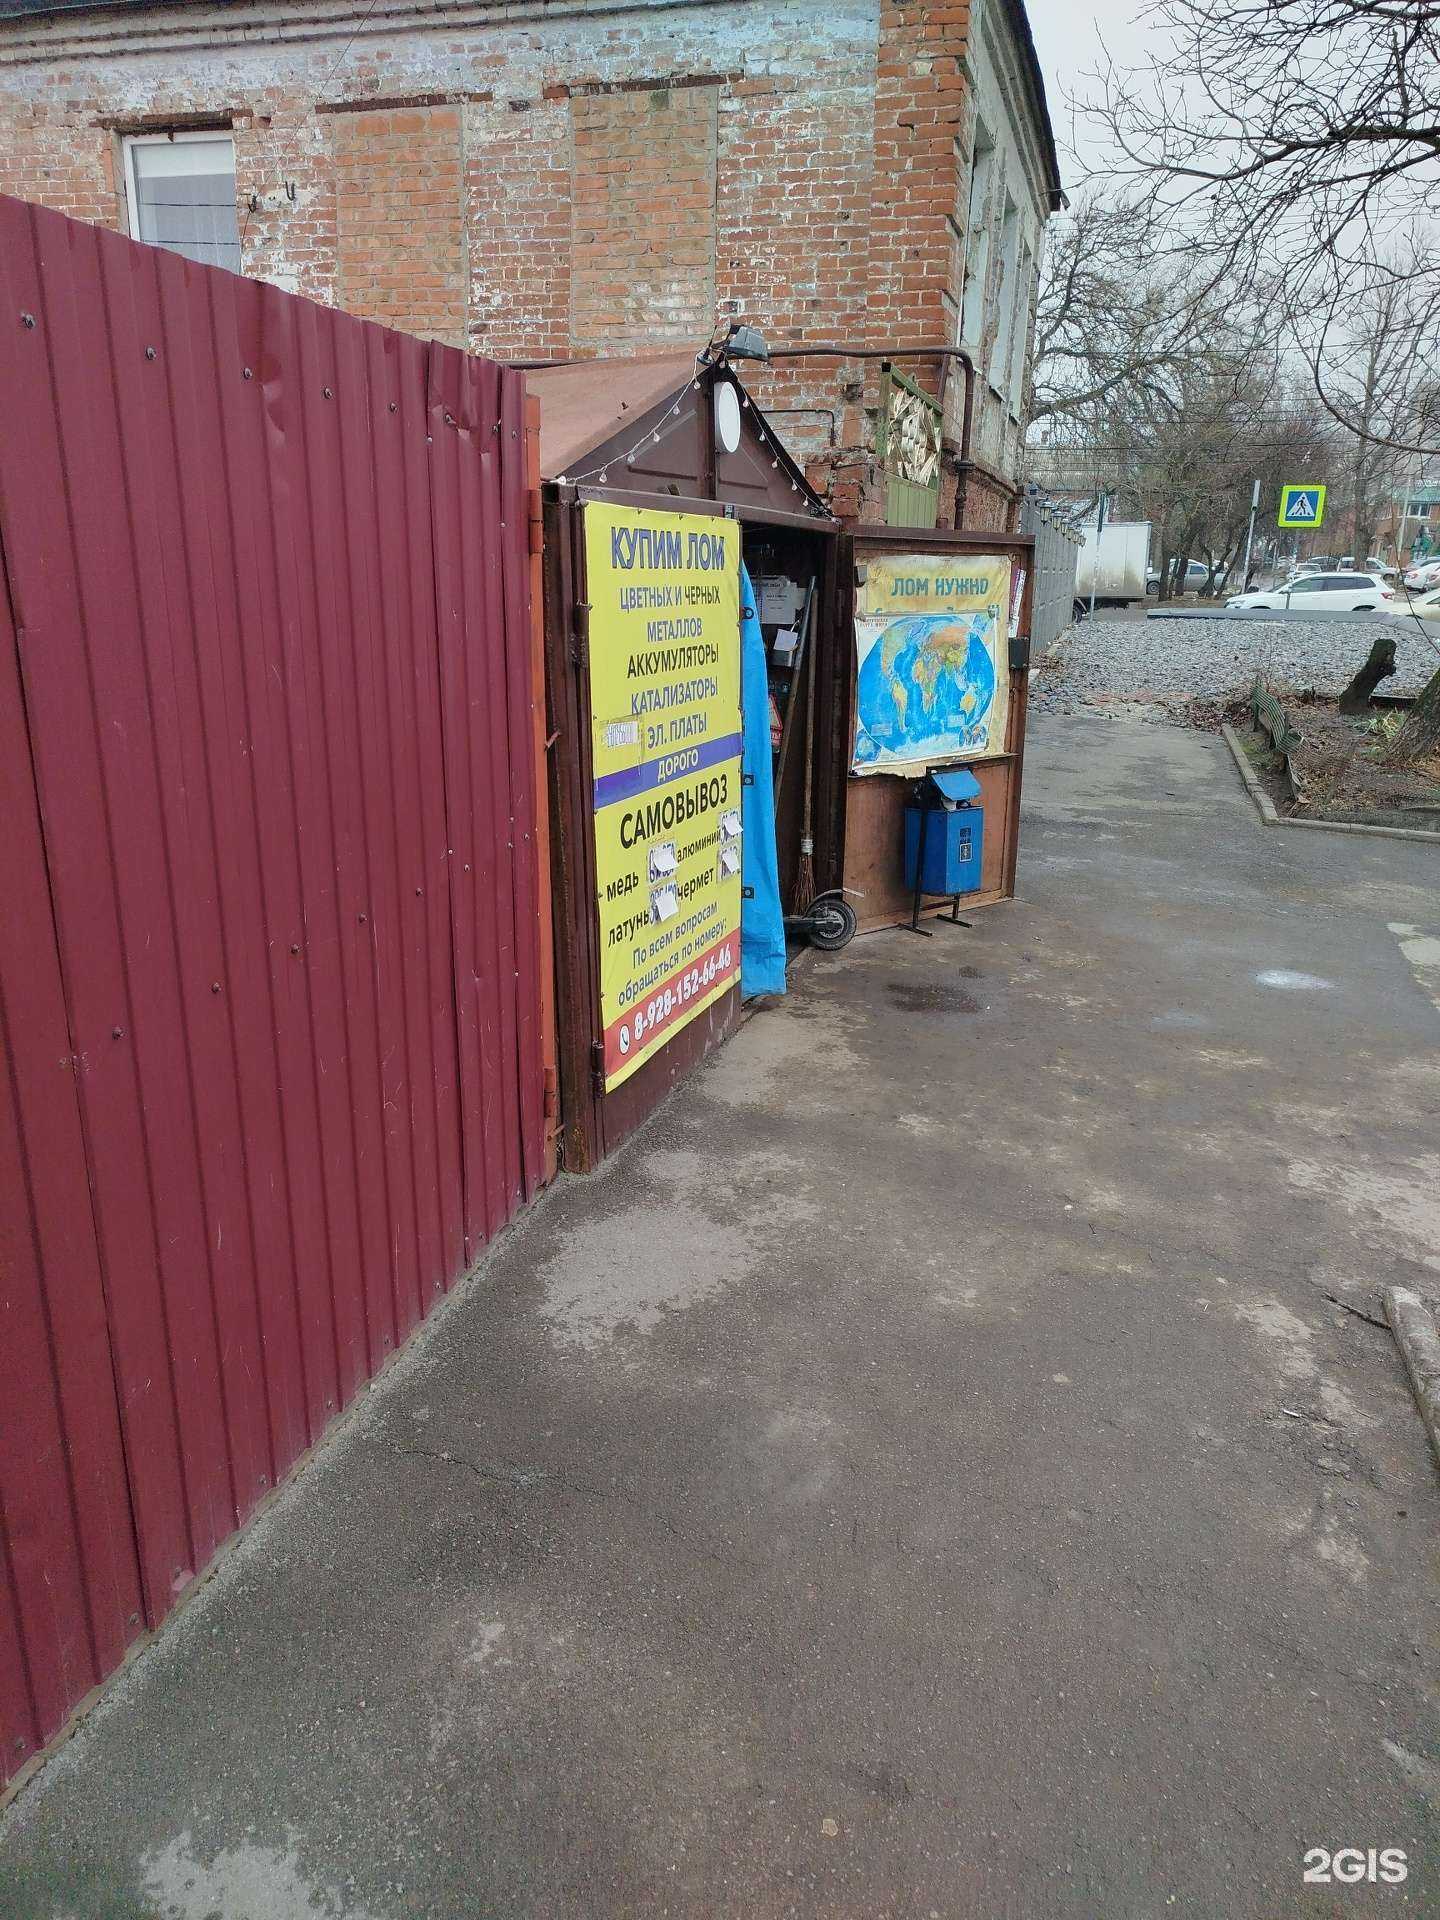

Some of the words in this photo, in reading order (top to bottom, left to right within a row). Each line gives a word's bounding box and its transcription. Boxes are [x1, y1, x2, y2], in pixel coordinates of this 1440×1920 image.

[611, 526, 682, 570] КУПИМ
[687, 533, 725, 571] ЛОМ
[620, 584, 673, 612] ЦВЕТНЫХ
[675, 585, 682, 606] И
[684, 585, 720, 605] ЧЕРНЫХ
[891, 577, 929, 597] ЛОМ
[935, 577, 989, 596] НУЖНО
[647, 617, 703, 642] МЕТАЛЛОВ
[627, 643, 719, 679] АККУМУЛЯТОРЫ
[631, 676, 718, 715] КАТАЛИЗАТОРЫ
[647, 721, 667, 749] ЭЛ.
[670, 712, 707, 740] ПЛАТЫ
[657, 748, 699, 783] ДОРОГО
[619, 774, 728, 849] САМОВЫВОЗ
[606, 872, 639, 902] медь
[608, 909, 650, 948] латунь
[677, 868, 714, 901] чермет
[633, 946, 647, 969] По
[650, 931, 673, 958] всем
[675, 901, 718, 939] вопросам
[618, 951, 679, 1006] обращаться
[681, 941, 692, 958] по
[634, 943, 732, 1040] 8-928-152-66-46
